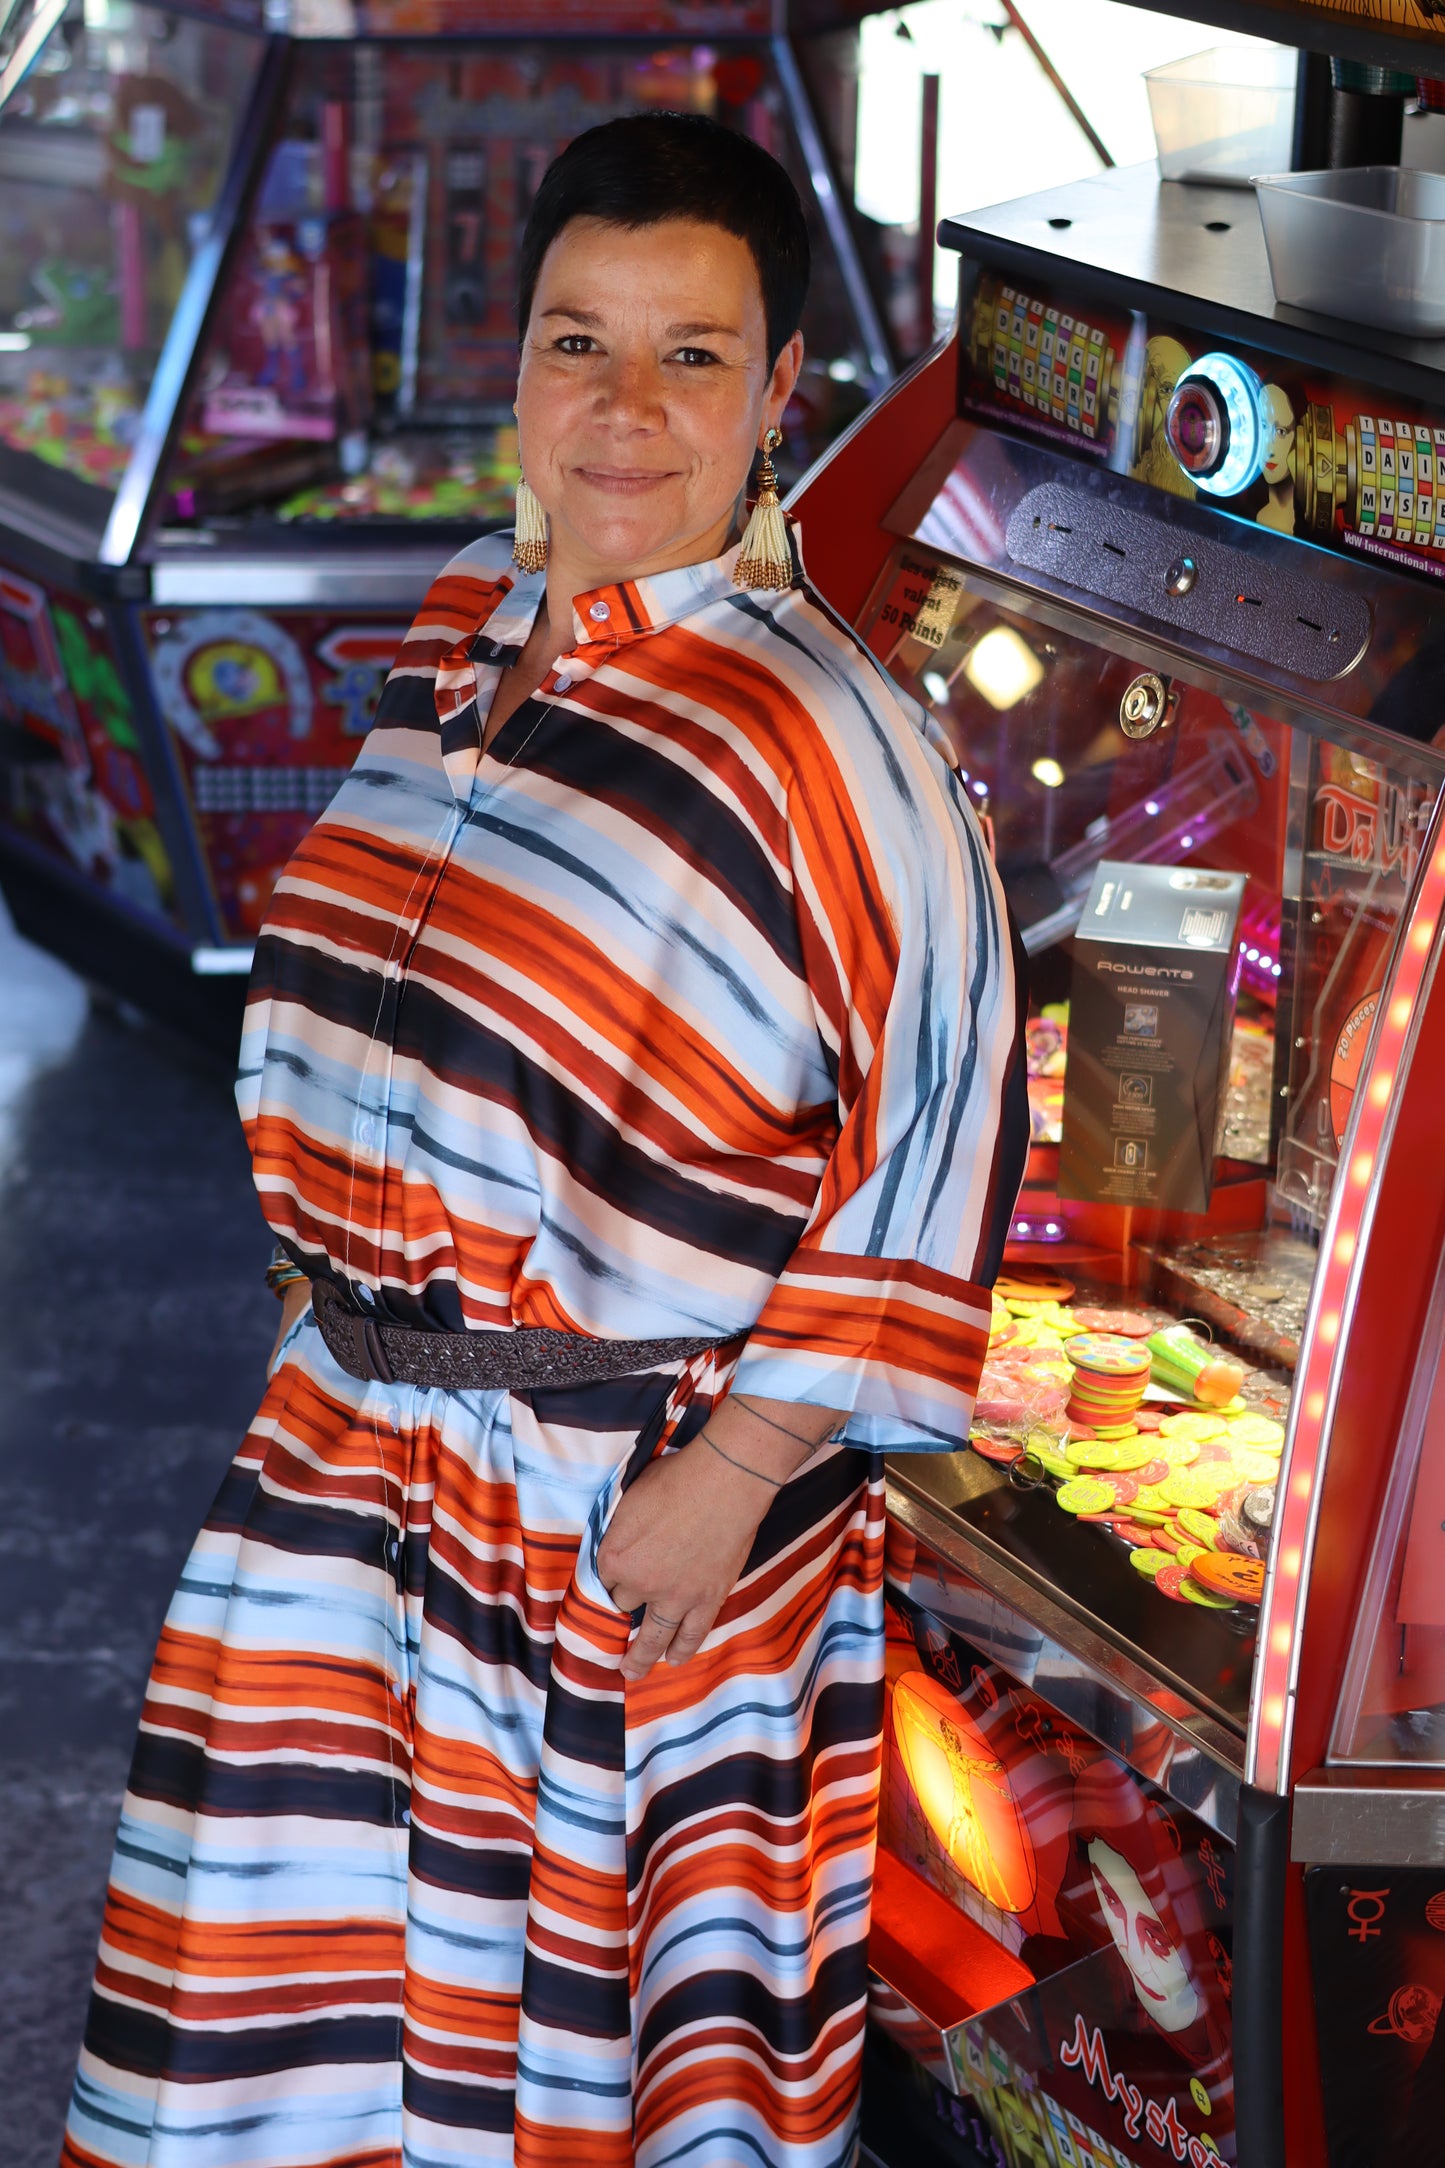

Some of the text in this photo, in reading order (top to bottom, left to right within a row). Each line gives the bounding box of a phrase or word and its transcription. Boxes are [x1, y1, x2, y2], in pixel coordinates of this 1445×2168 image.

[1344, 531, 1363, 548] VdW
[1364, 539, 1429, 573] International
[881, 604, 944, 645] 50 Points
[1117, 985, 1170, 998] HEAD SHAVER
[1337, 1036, 1349, 1061] 20
